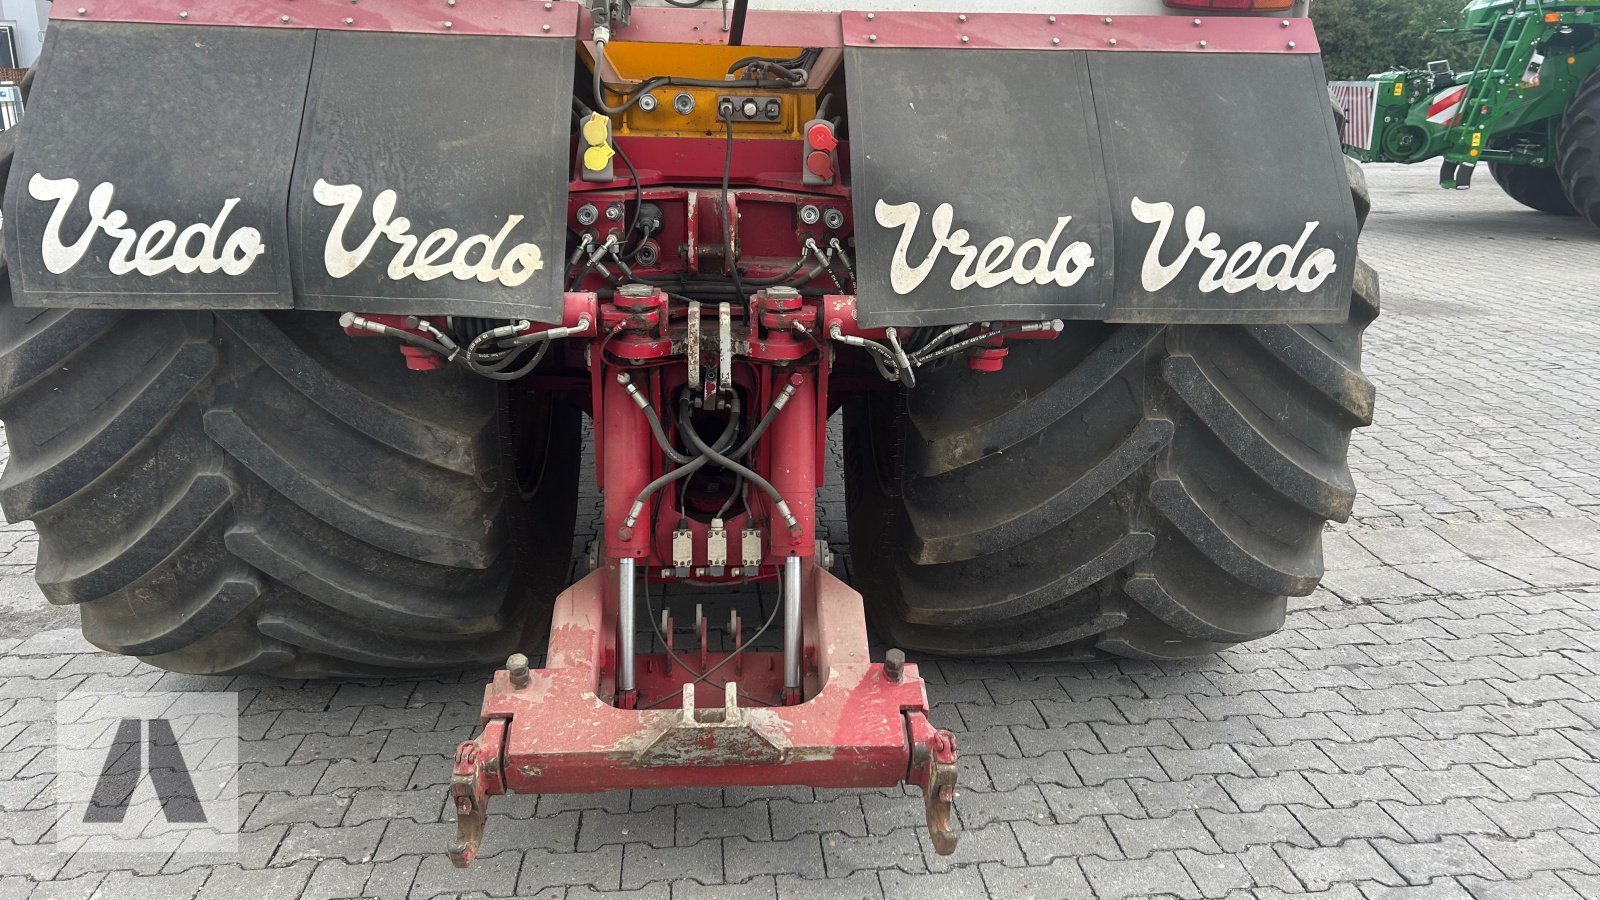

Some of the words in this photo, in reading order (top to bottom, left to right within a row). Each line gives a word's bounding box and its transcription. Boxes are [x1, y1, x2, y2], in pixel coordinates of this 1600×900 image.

[28, 172, 265, 276] Vredo
[312, 177, 545, 287] Vredo
[874, 198, 1095, 295] Vredo
[1130, 195, 1337, 294] Vredo
